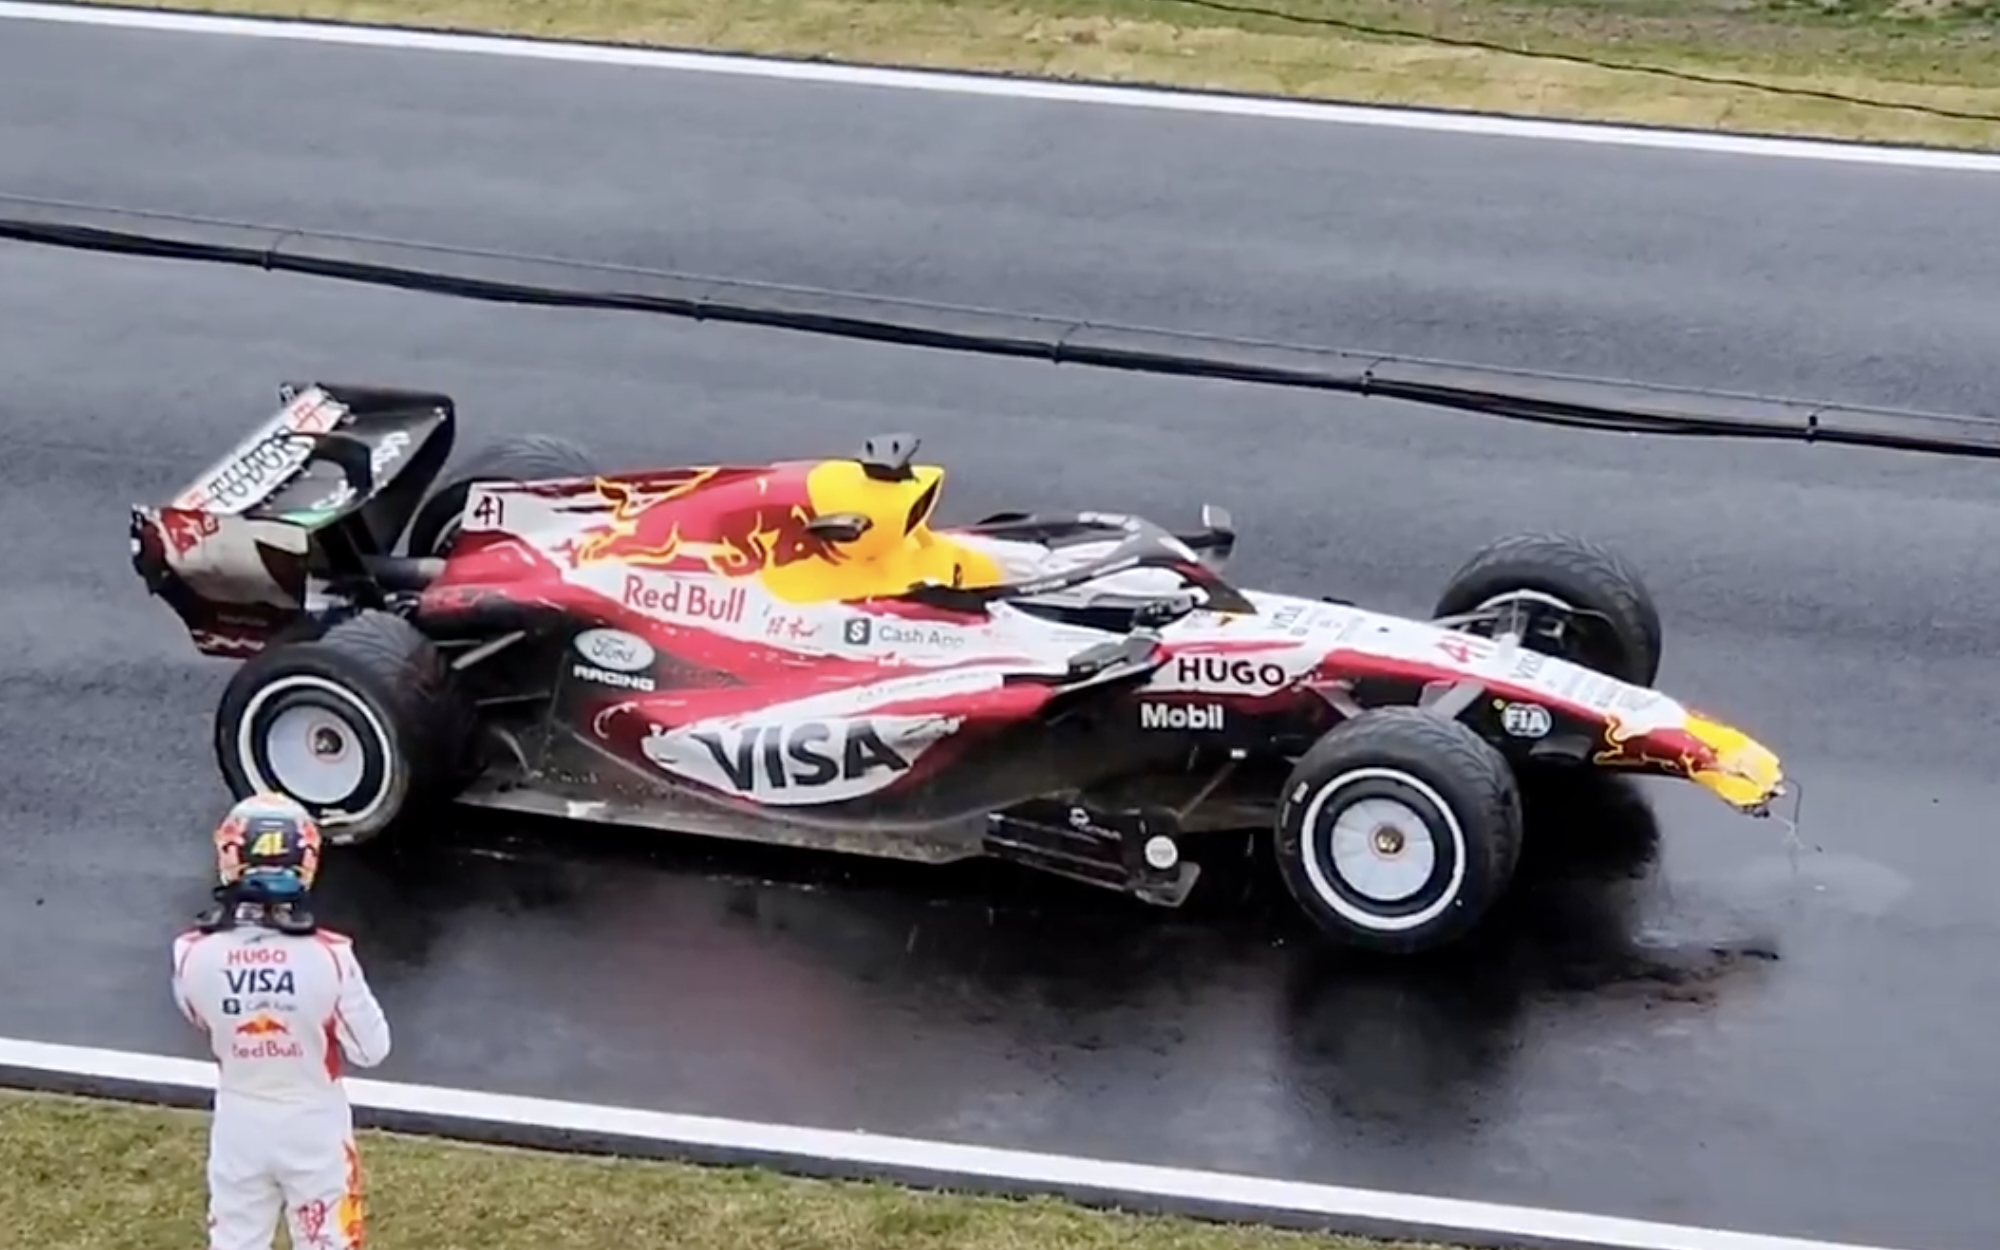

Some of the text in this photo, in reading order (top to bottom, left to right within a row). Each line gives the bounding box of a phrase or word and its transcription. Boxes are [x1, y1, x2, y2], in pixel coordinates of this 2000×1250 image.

[473, 495, 504, 526] 41
[624, 573, 746, 623] Red Bull
[879, 624, 924, 645] Cash
[573, 664, 655, 691] RACING
[1178, 657, 1285, 686] HUGO
[1141, 702, 1224, 730] Mobil
[1507, 706, 1548, 735] FIA
[689, 721, 910, 791] VISA
[228, 948, 287, 965] HUGO
[221, 967, 295, 994] VISA
